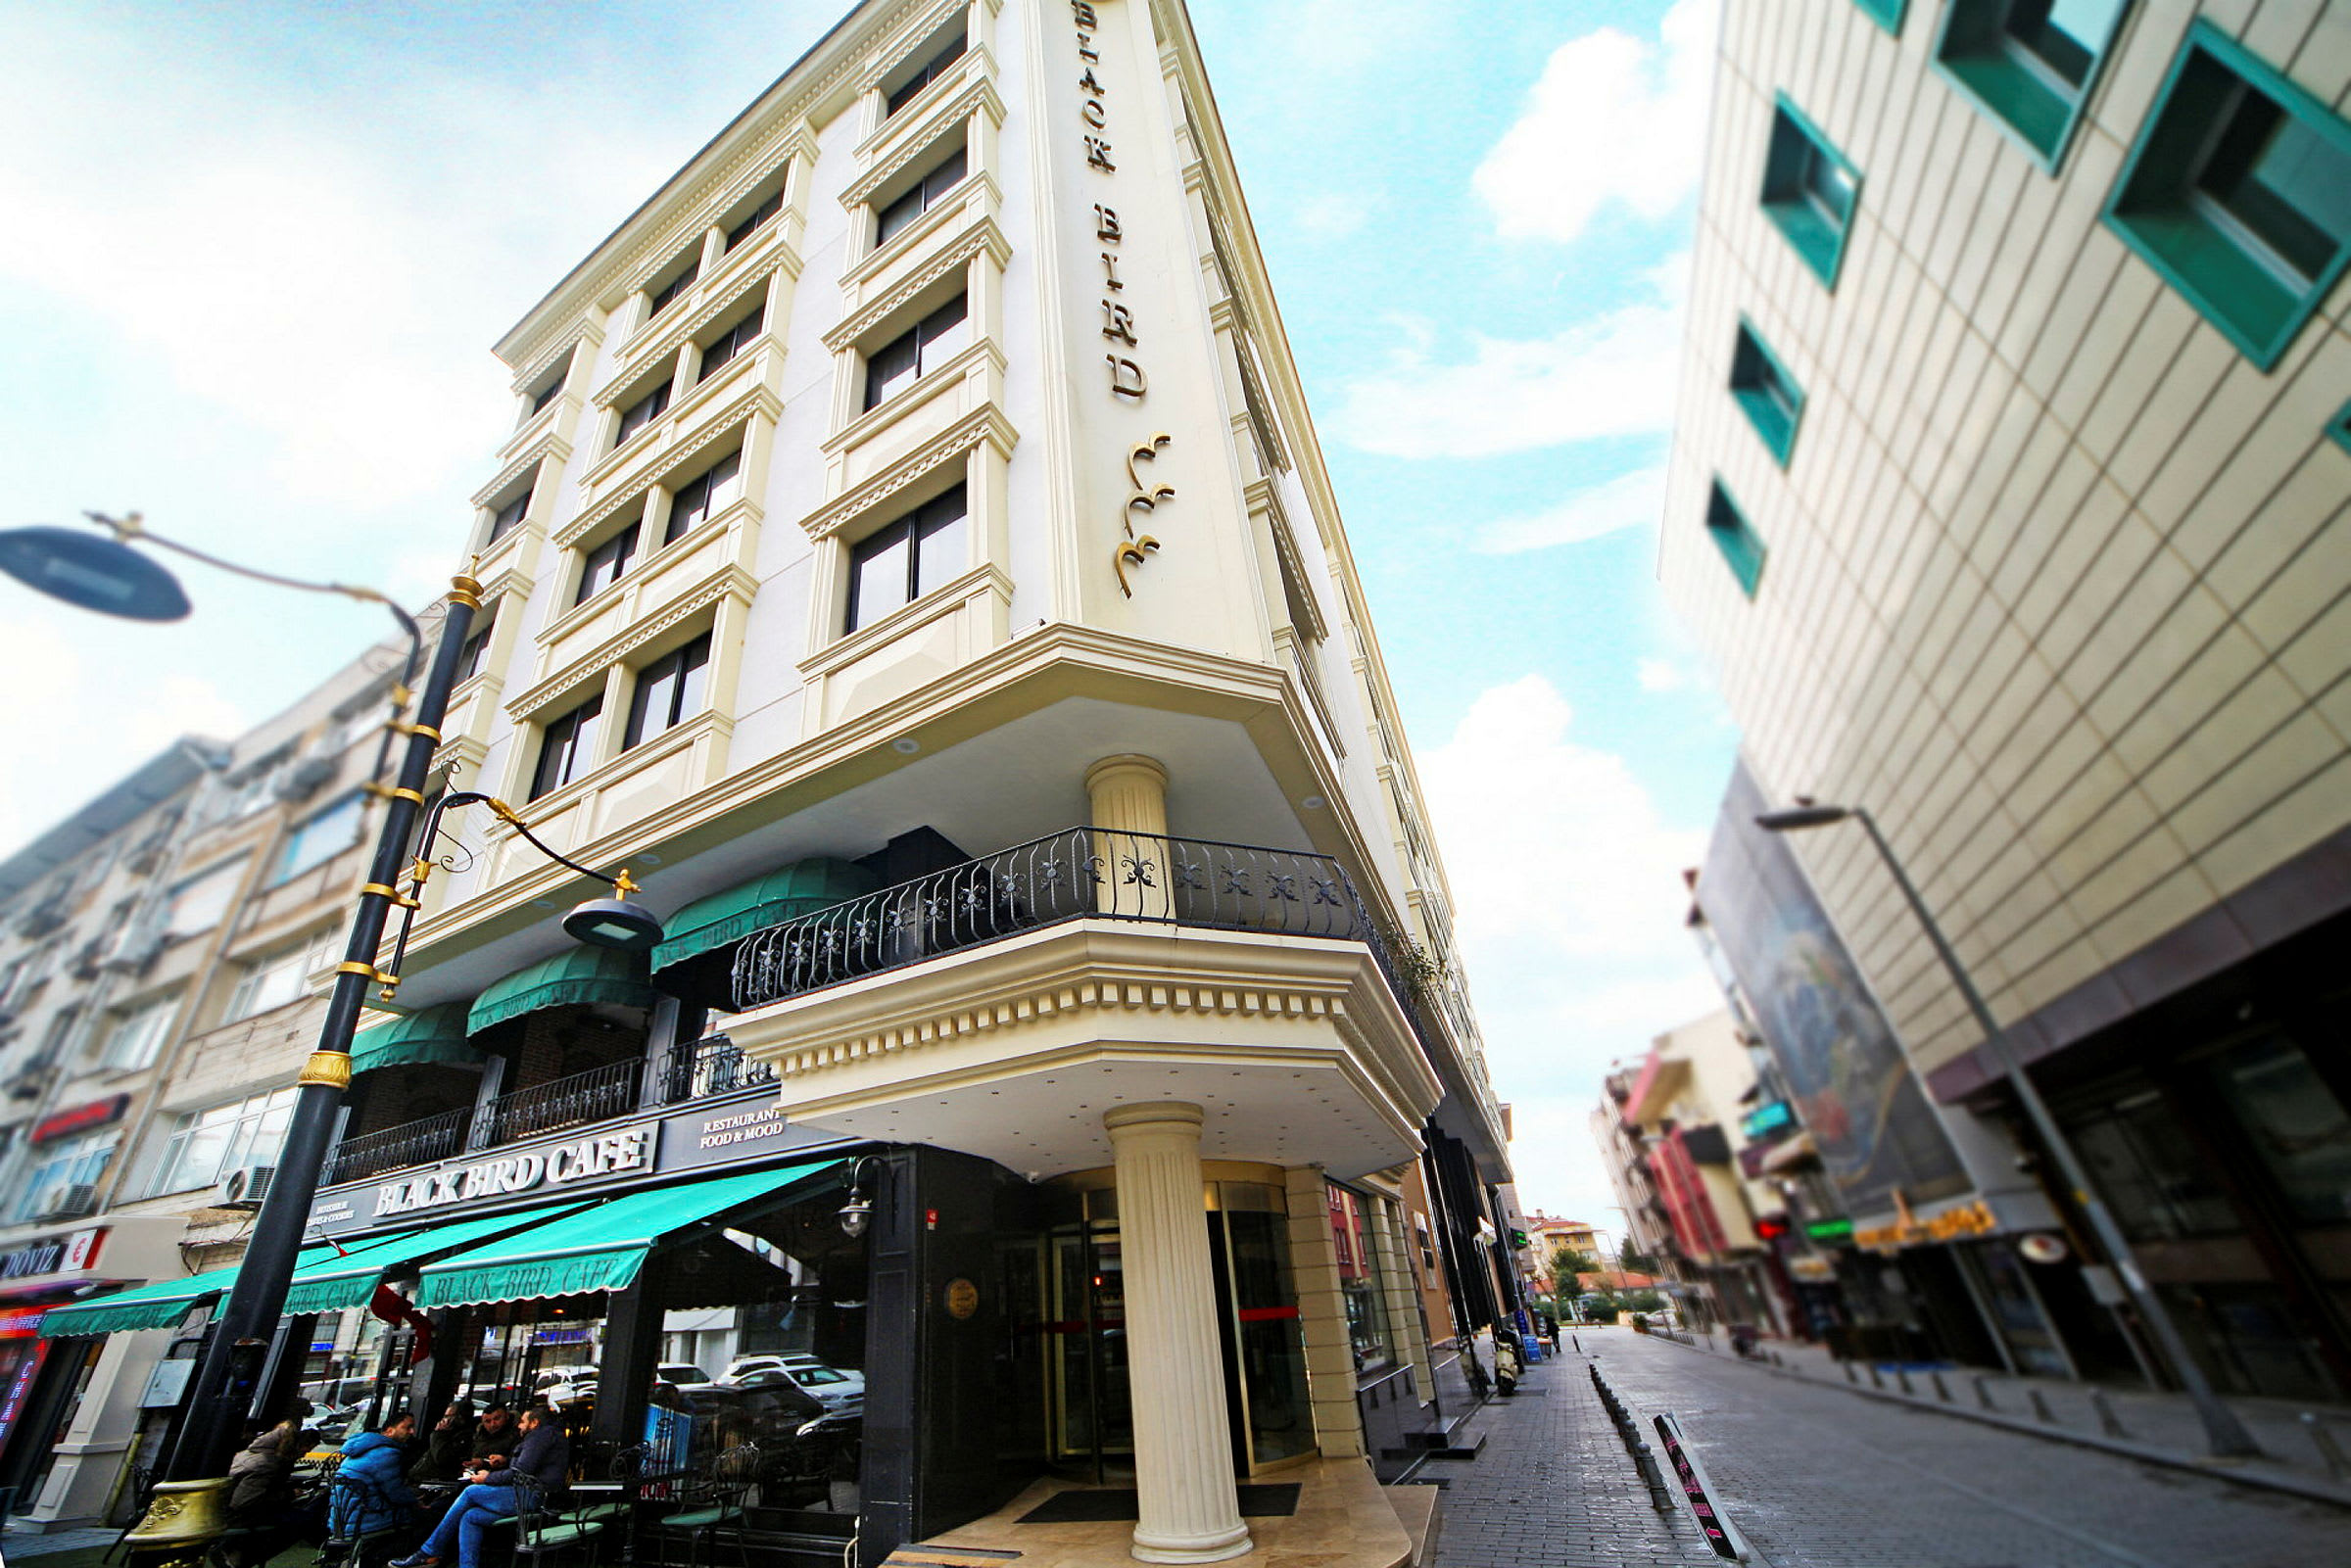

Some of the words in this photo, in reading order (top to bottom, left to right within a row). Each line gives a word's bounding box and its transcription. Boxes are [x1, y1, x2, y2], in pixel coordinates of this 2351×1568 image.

[1071, 0, 1118, 173] BLACK
[1093, 203, 1148, 399] BIRD
[700, 1132, 733, 1149] FOOD
[733, 1131, 743, 1143] &
[744, 1122, 784, 1141] MOOD
[703, 1109, 781, 1133] RESTAURANT
[372, 1169, 464, 1217] BLACK
[460, 1153, 545, 1201] BIRD
[547, 1130, 649, 1183] CAFE
[434, 1273, 494, 1304] BLACK
[504, 1266, 553, 1298] BIRD
[562, 1258, 619, 1292] CAFE
